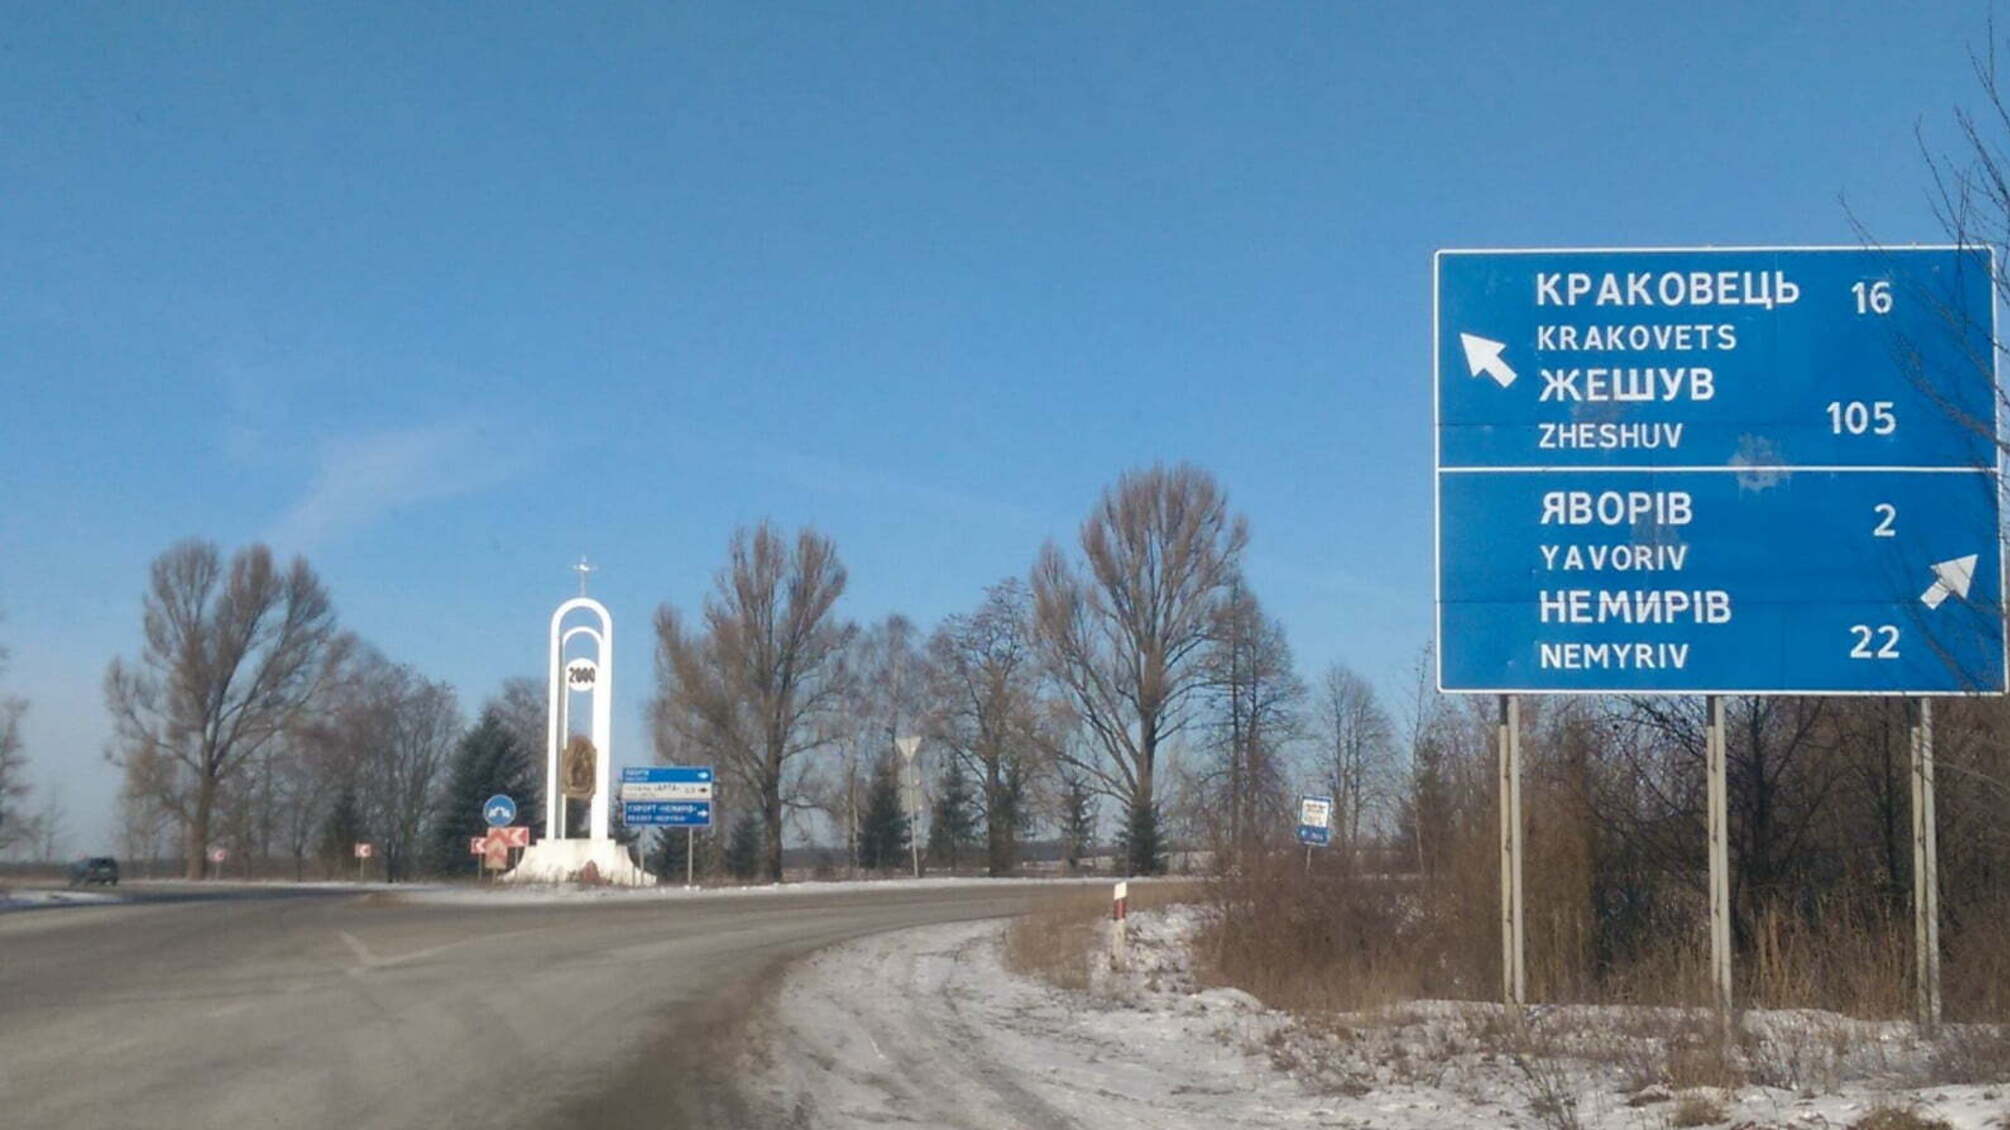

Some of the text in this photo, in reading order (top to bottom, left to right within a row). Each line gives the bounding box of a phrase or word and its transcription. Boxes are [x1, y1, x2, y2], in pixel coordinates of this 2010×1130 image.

[1536, 271, 1893, 315] КРАКОВЕЦЬ 16
[1537, 324, 1737, 350] KRAKOVETS
[1539, 367, 1715, 402] ЖЕШУВ
[1826, 401, 1897, 435] 105
[1538, 423, 1683, 449] ZHESHUV
[1540, 491, 1897, 537] ЯВОРІВ 2
[1540, 545, 1688, 571] YAVORIV
[1539, 590, 1732, 624] НЕМИРІВ
[1539, 643, 1689, 669] NEMYRIV
[1849, 625, 1900, 659] 22
